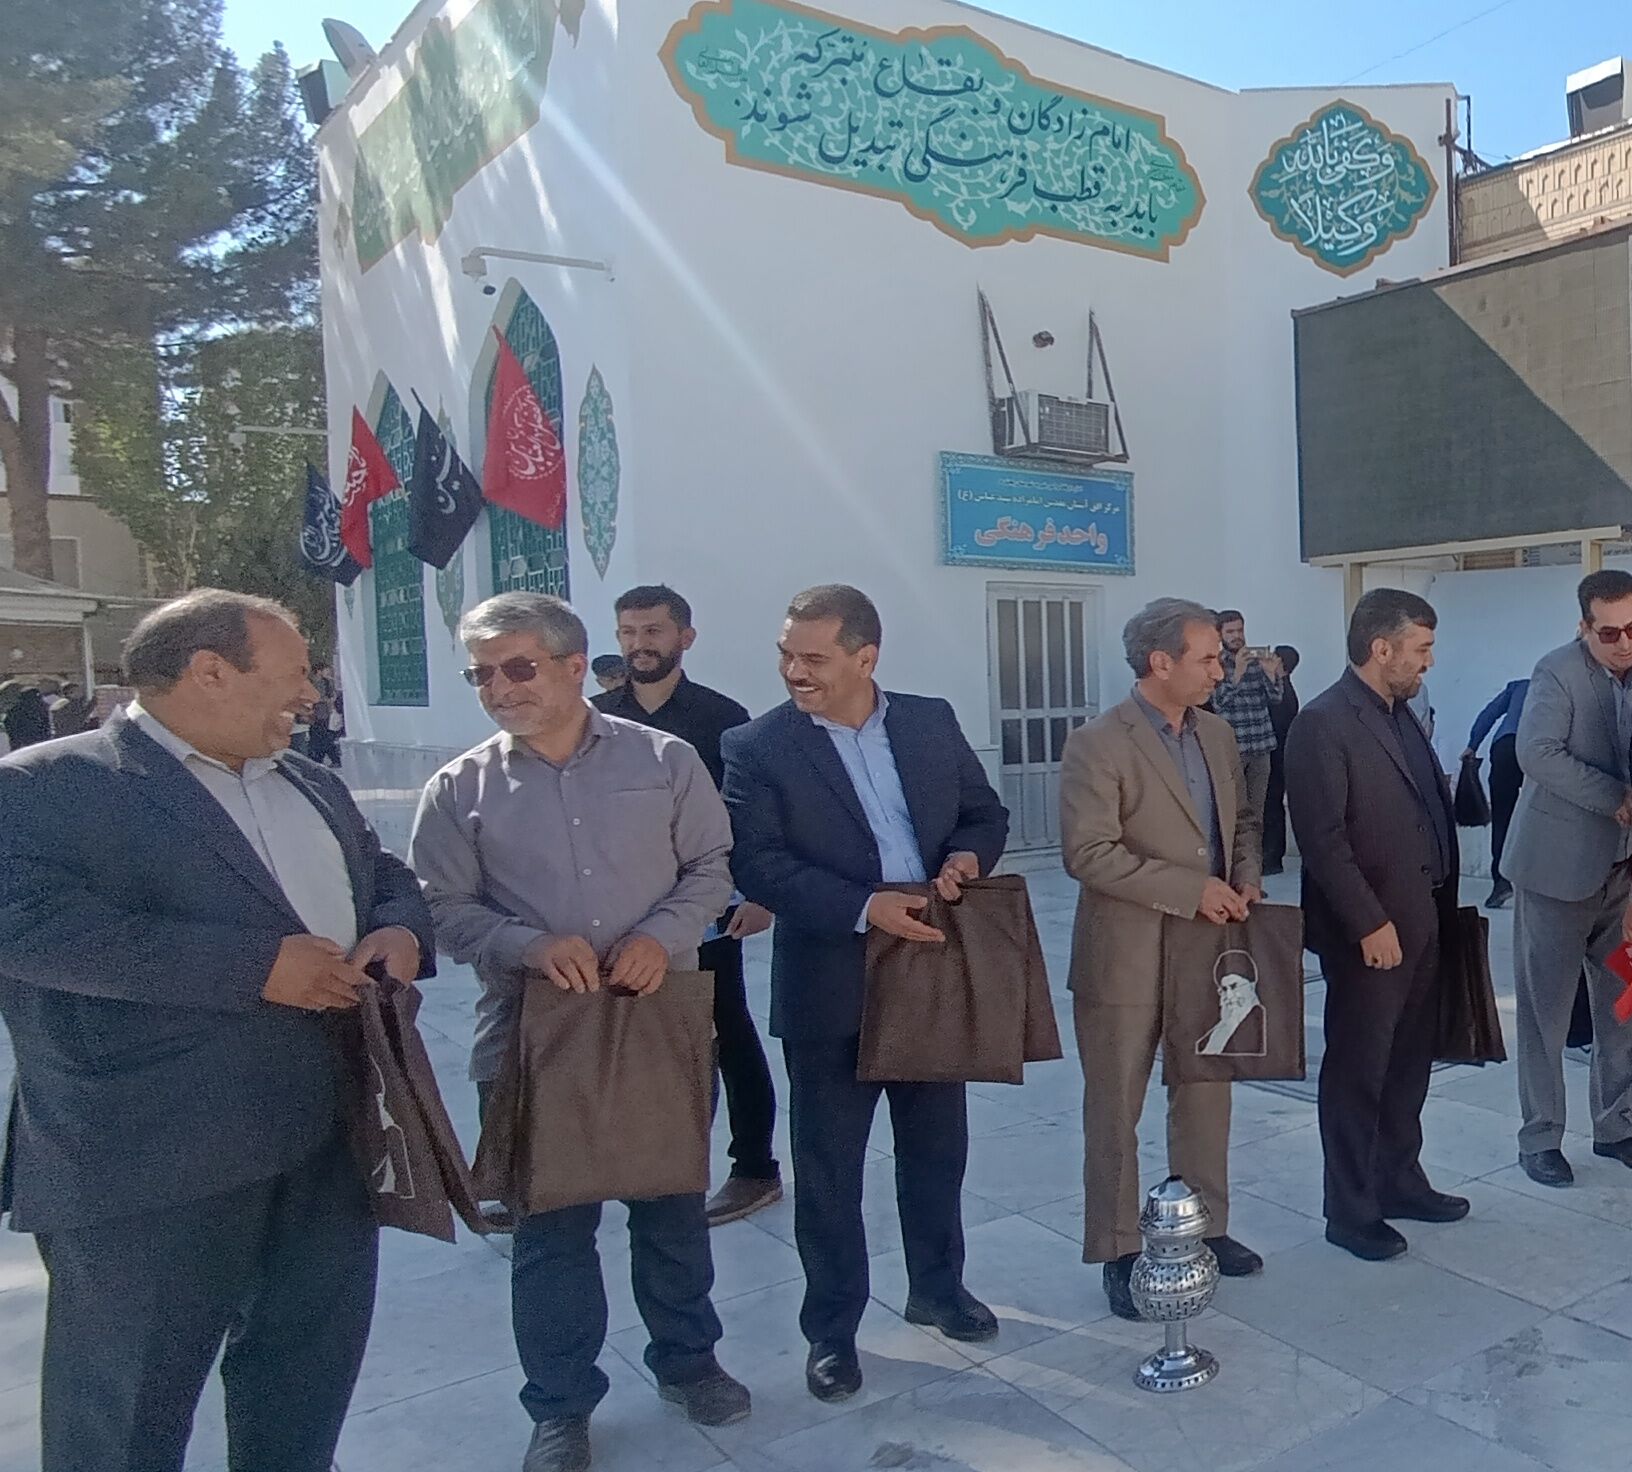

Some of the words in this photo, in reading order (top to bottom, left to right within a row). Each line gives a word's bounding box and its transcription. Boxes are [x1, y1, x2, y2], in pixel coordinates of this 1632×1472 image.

[873, 52, 984, 114] بقاع
[734, 82, 812, 132] شوند
[987, 97, 1000, 115] و
[818, 111, 904, 172] تبدیل
[904, 108, 1029, 200] فرهنگی
[1033, 166, 1106, 213] قطب
[1104, 203, 1123, 228] به
[1127, 194, 1158, 238] باید
[974, 515, 1057, 551] فرهنگی
[1057, 521, 1109, 555] واحد
